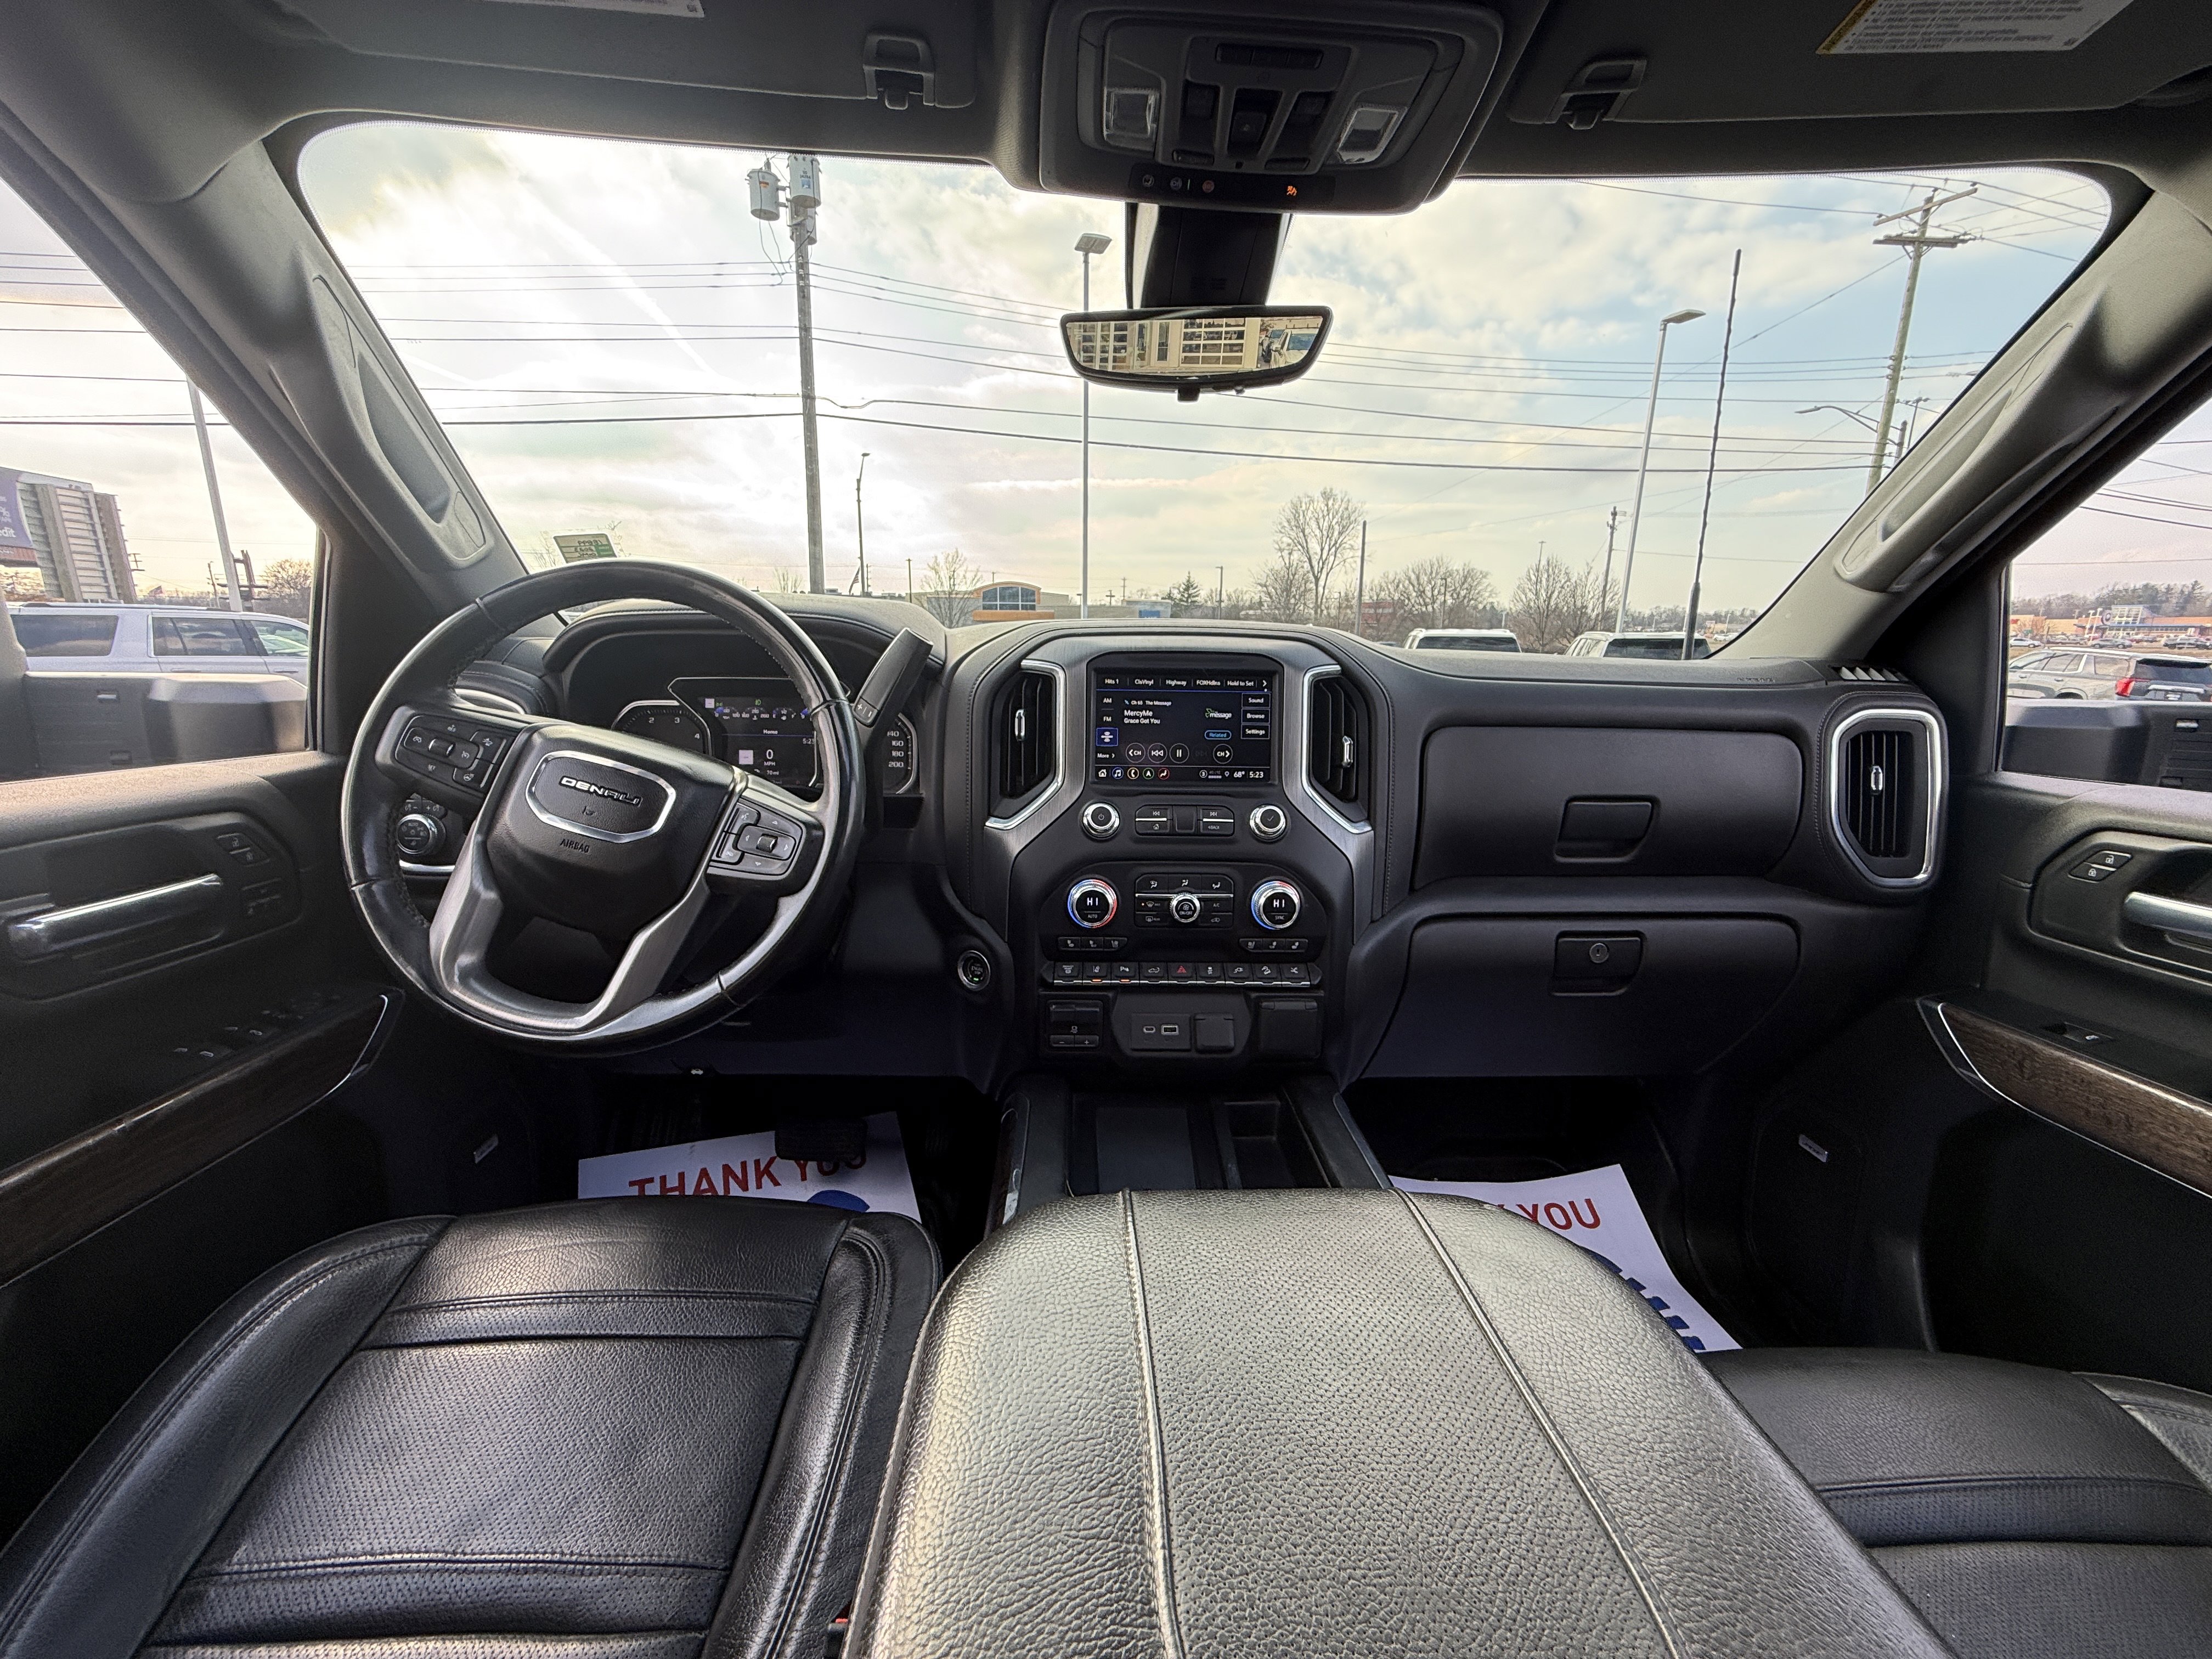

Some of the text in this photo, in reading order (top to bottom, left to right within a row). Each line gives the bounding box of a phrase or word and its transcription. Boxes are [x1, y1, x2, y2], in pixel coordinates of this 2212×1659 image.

[1124, 709, 1153, 718] MercyMe
[766, 749, 774, 759] 0
[560, 776, 643, 808] DENALI
[560, 838, 590, 853] AIRBAG
[1087, 897, 1098, 906] HI
[1273, 899, 1285, 908] HI
[628, 1156, 781, 1196] THANK
[1516, 1198, 1601, 1231] YOU
